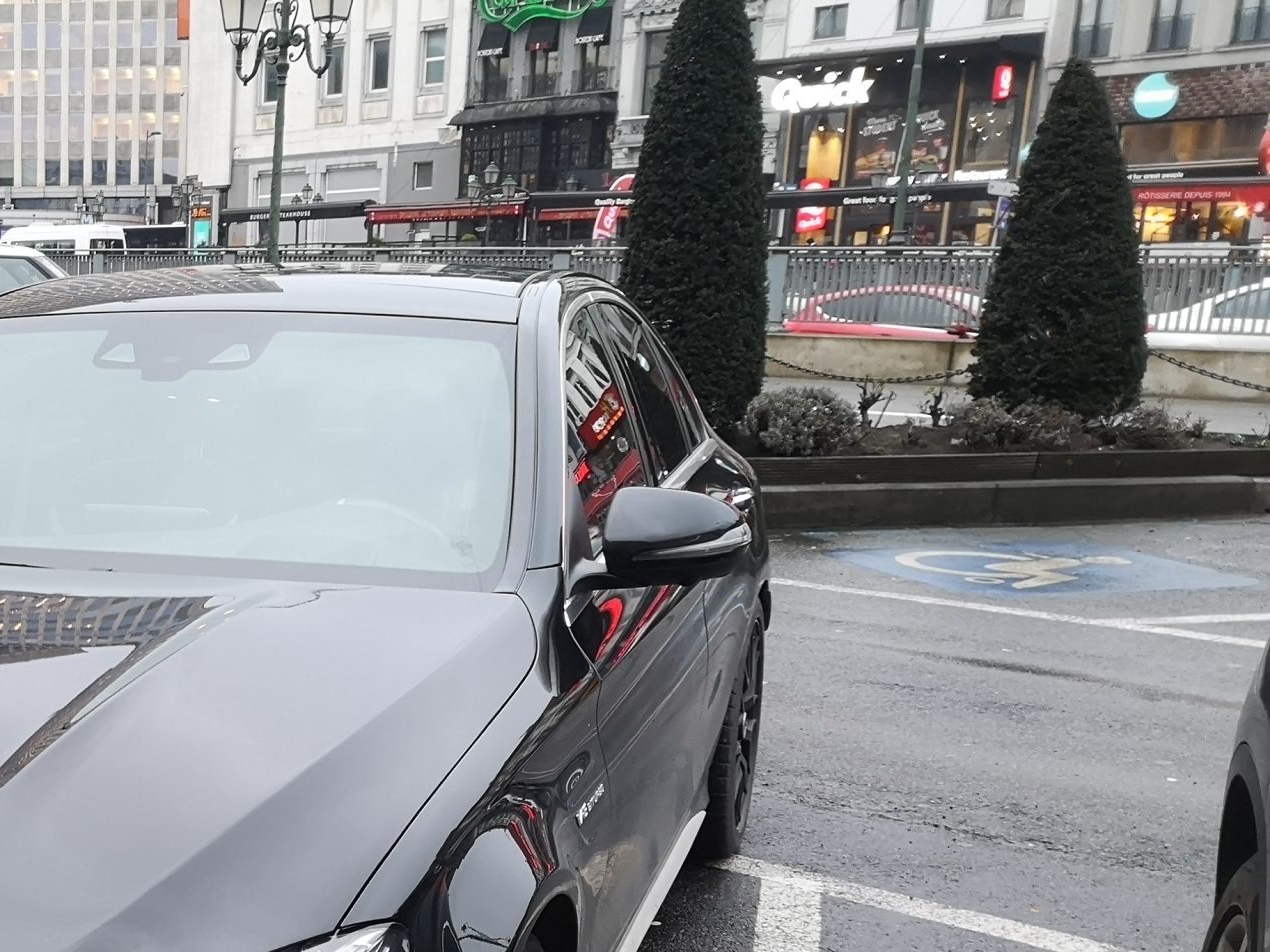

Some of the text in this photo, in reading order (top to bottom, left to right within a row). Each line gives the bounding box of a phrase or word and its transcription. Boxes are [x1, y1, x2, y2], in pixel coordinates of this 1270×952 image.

[771, 66, 875, 113] Quick
[1184, 191, 1212, 199] DEPUIS
[279, 210, 311, 218] TEAKHOUSE
[798, 215, 822, 228] Quick
